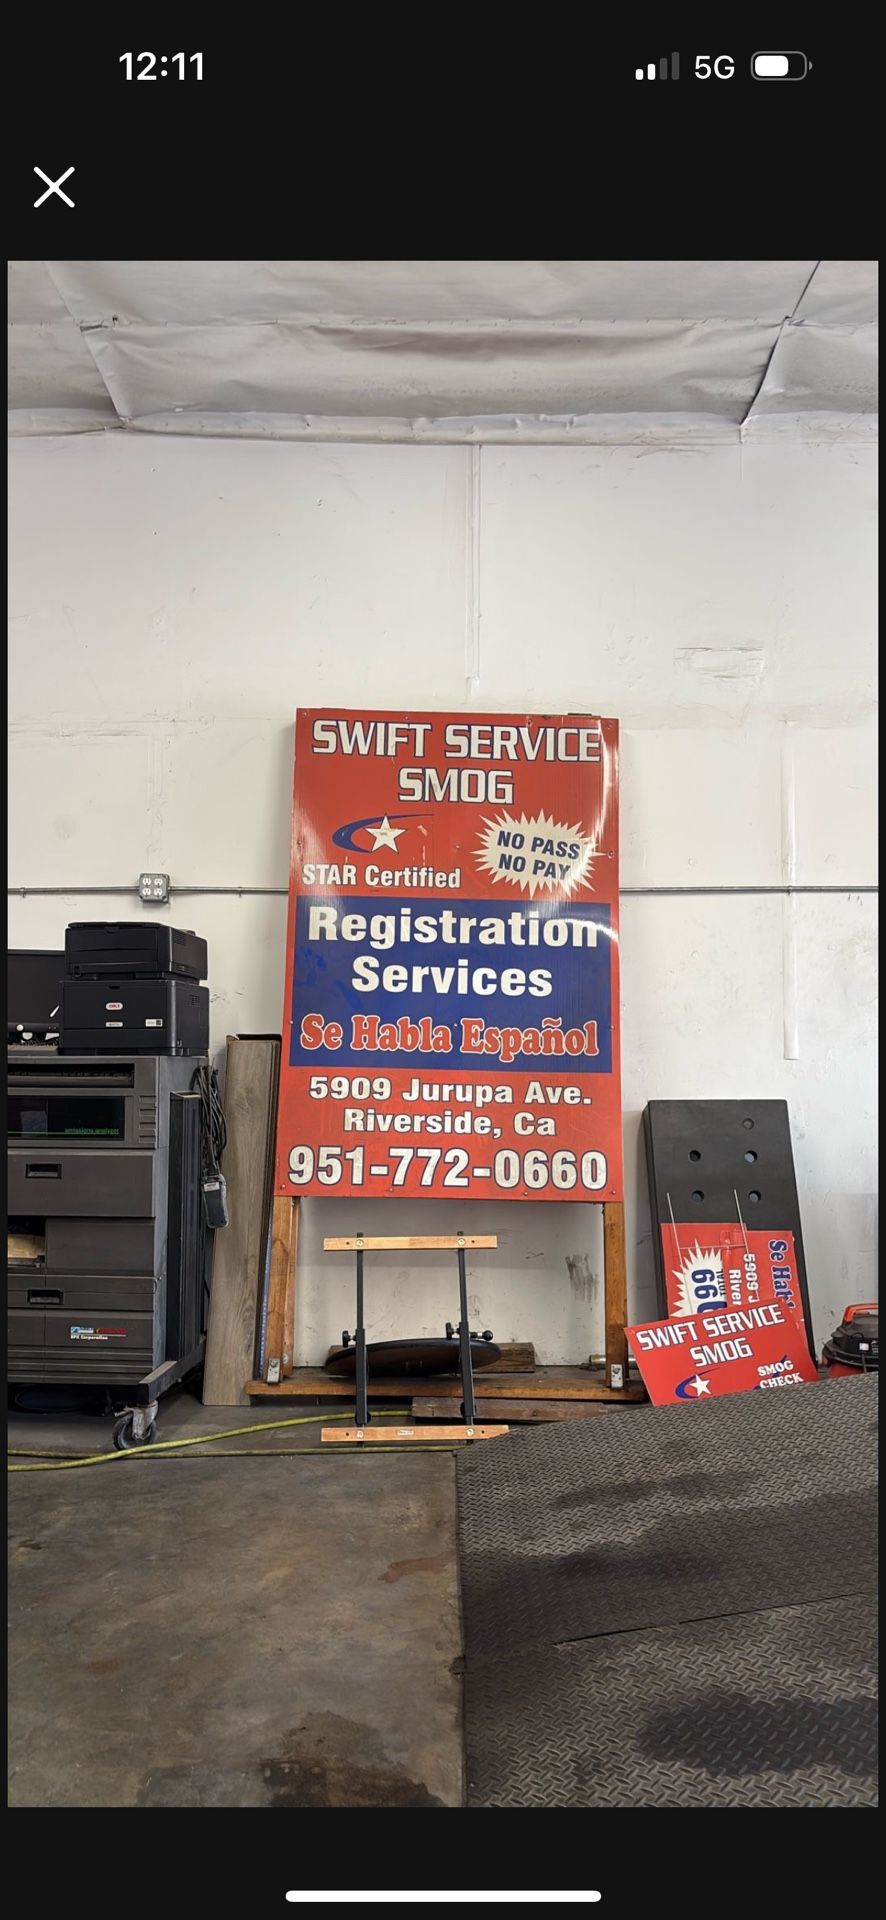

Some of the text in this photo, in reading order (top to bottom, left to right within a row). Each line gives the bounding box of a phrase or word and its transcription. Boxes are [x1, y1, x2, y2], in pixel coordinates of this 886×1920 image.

[312, 719, 601, 762] SWIFT SERVICE
[398, 767, 515, 805] SMOG
[497, 830, 581, 860] NO PASS
[302, 863, 462, 889] STAR Certified
[498, 853, 572, 880] NO PAY
[307, 905, 599, 950] Registration
[351, 955, 553, 997] Services
[300, 1013, 600, 1063] Se Habla Español
[308, 1075, 593, 1108] 5909 Jurupa Ave.
[343, 1107, 557, 1140] Riverside, Ca
[287, 1144, 609, 1191] 951-772-0660
[768, 1239, 788, 1262] Se
[743, 1253, 758, 1291] 5909
[636, 1304, 785, 1351] SWIFT SERVICE
[690, 1337, 753, 1367] SMOG
[757, 1360, 794, 1377] SMOG
[759, 1372, 804, 1389] CHECK
